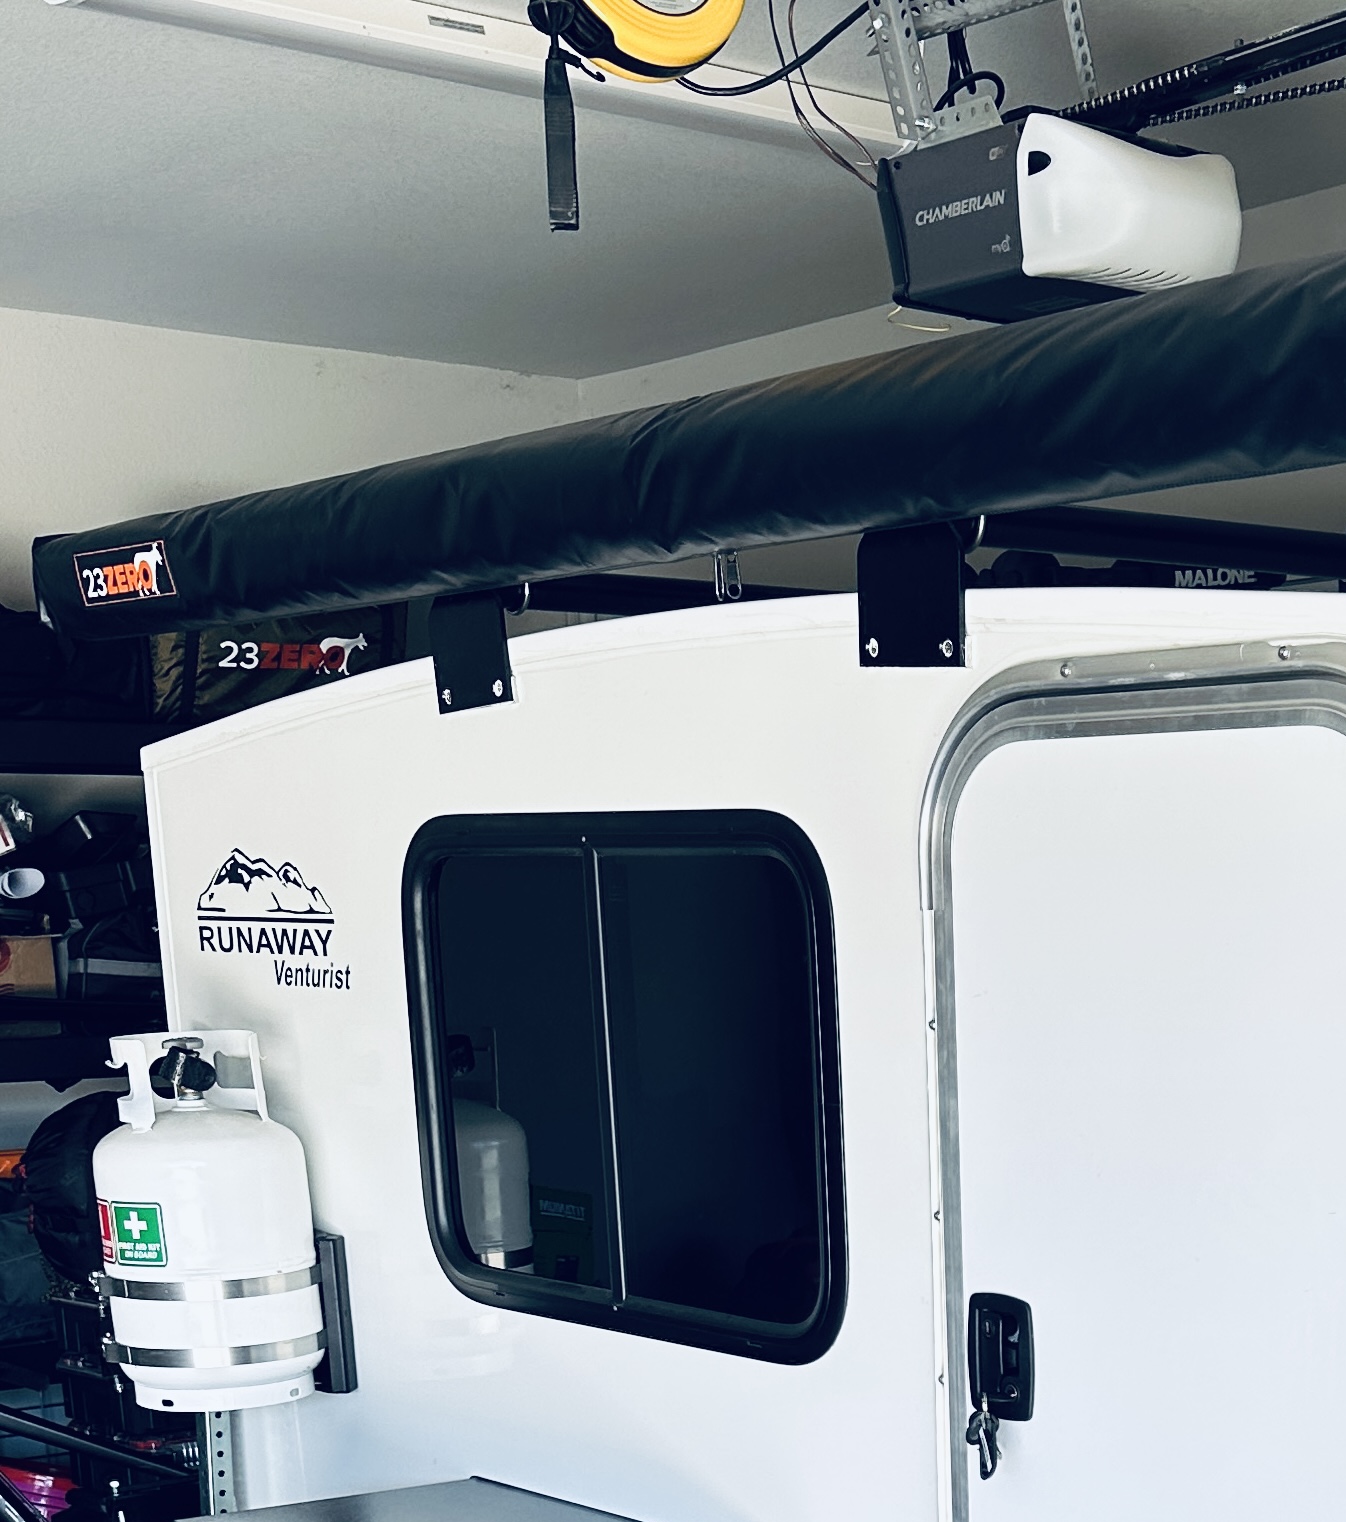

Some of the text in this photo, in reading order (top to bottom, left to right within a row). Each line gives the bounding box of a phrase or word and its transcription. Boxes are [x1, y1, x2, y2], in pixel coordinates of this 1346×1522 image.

[915, 189, 1006, 227] CHAMBERLAIN
[82, 559, 153, 598] 23ZERO
[1174, 567, 1258, 588] MALONE
[218, 640, 346, 671] 23ZERO
[198, 925, 333, 957] RUNAWAY
[273, 959, 351, 990] Venturist
